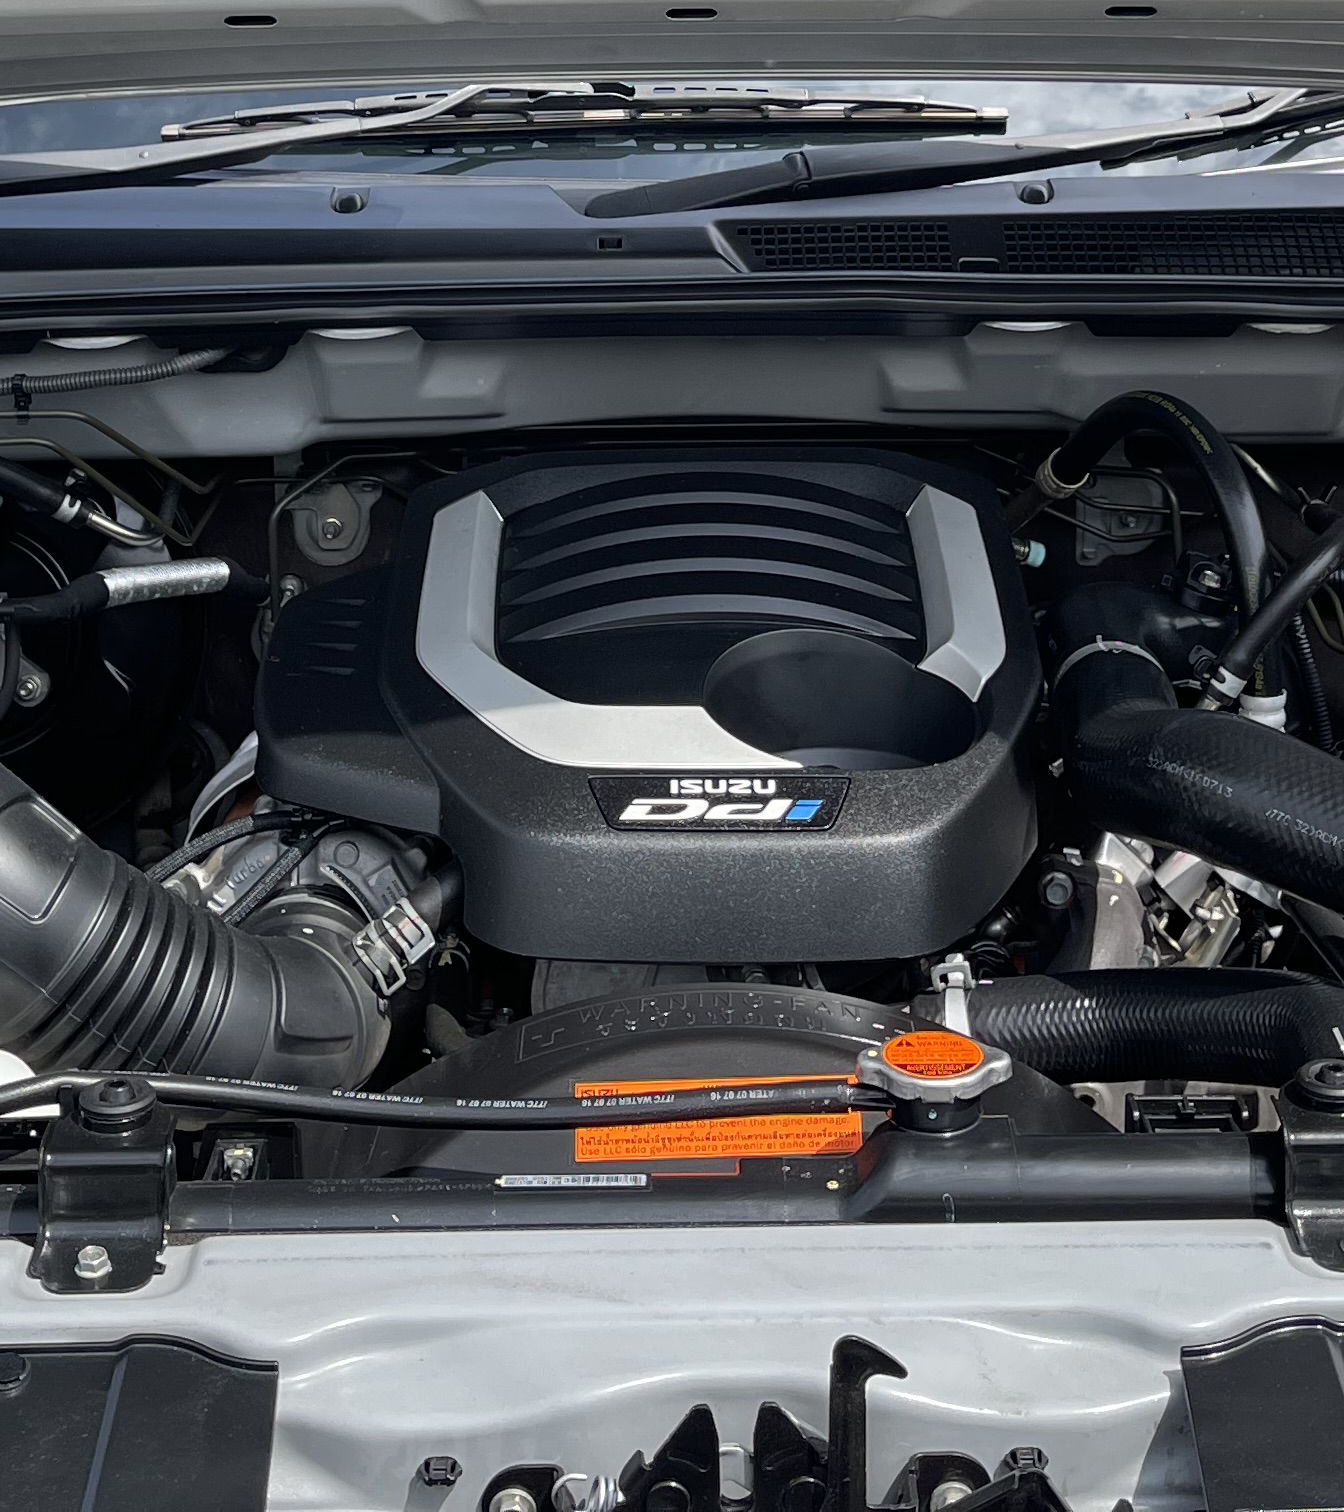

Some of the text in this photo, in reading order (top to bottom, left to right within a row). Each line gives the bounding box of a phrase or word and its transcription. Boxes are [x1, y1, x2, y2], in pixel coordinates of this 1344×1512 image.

[669, 779, 777, 794] ISUZU
[367, 1092, 402, 1102] WATER
[748, 1089, 774, 1099] ATER
[491, 1099, 525, 1107] WATER
[617, 1096, 652, 1105] WATER
[709, 1119, 747, 1128] prevent
[750, 1118, 766, 1127] the
[770, 1117, 803, 1127] engine
[580, 1147, 600, 1156] Use
[603, 1147, 622, 1155] LLC
[694, 1143, 718, 1153] para
[808, 1139, 820, 1147] de
